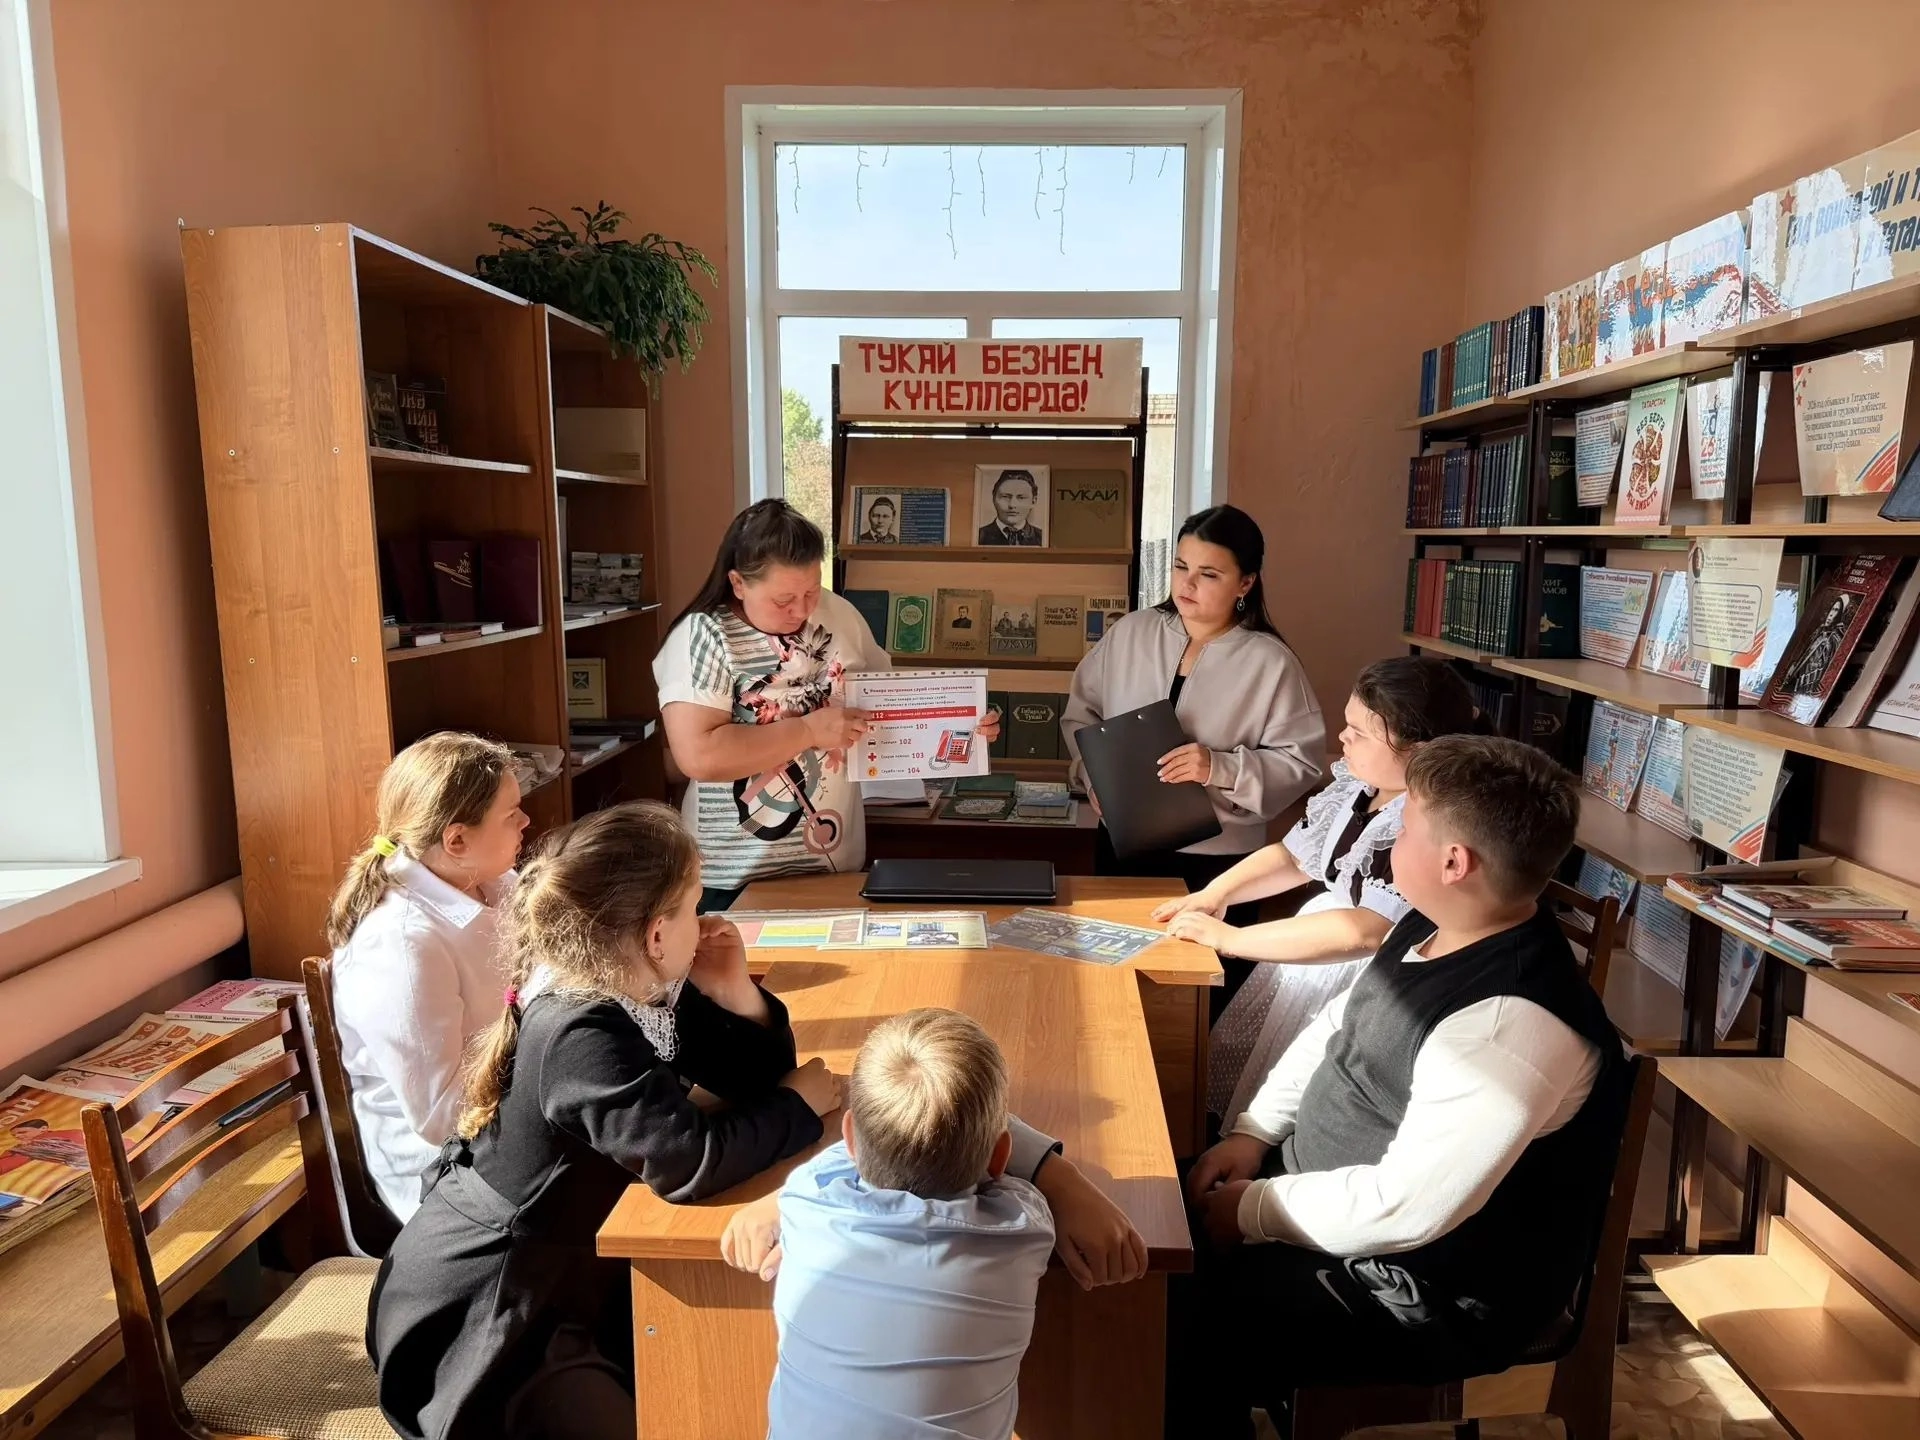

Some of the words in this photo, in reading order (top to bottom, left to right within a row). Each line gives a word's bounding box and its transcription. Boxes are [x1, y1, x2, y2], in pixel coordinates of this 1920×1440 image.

[858, 341, 956, 375] ТУКАЙ
[982, 344, 1104, 378] БЕЗНЕҢ
[884, 379, 1088, 414] КҮҢЕЛЛӘРДӘ!
[1056, 488, 1119, 501] ТУКАЙ
